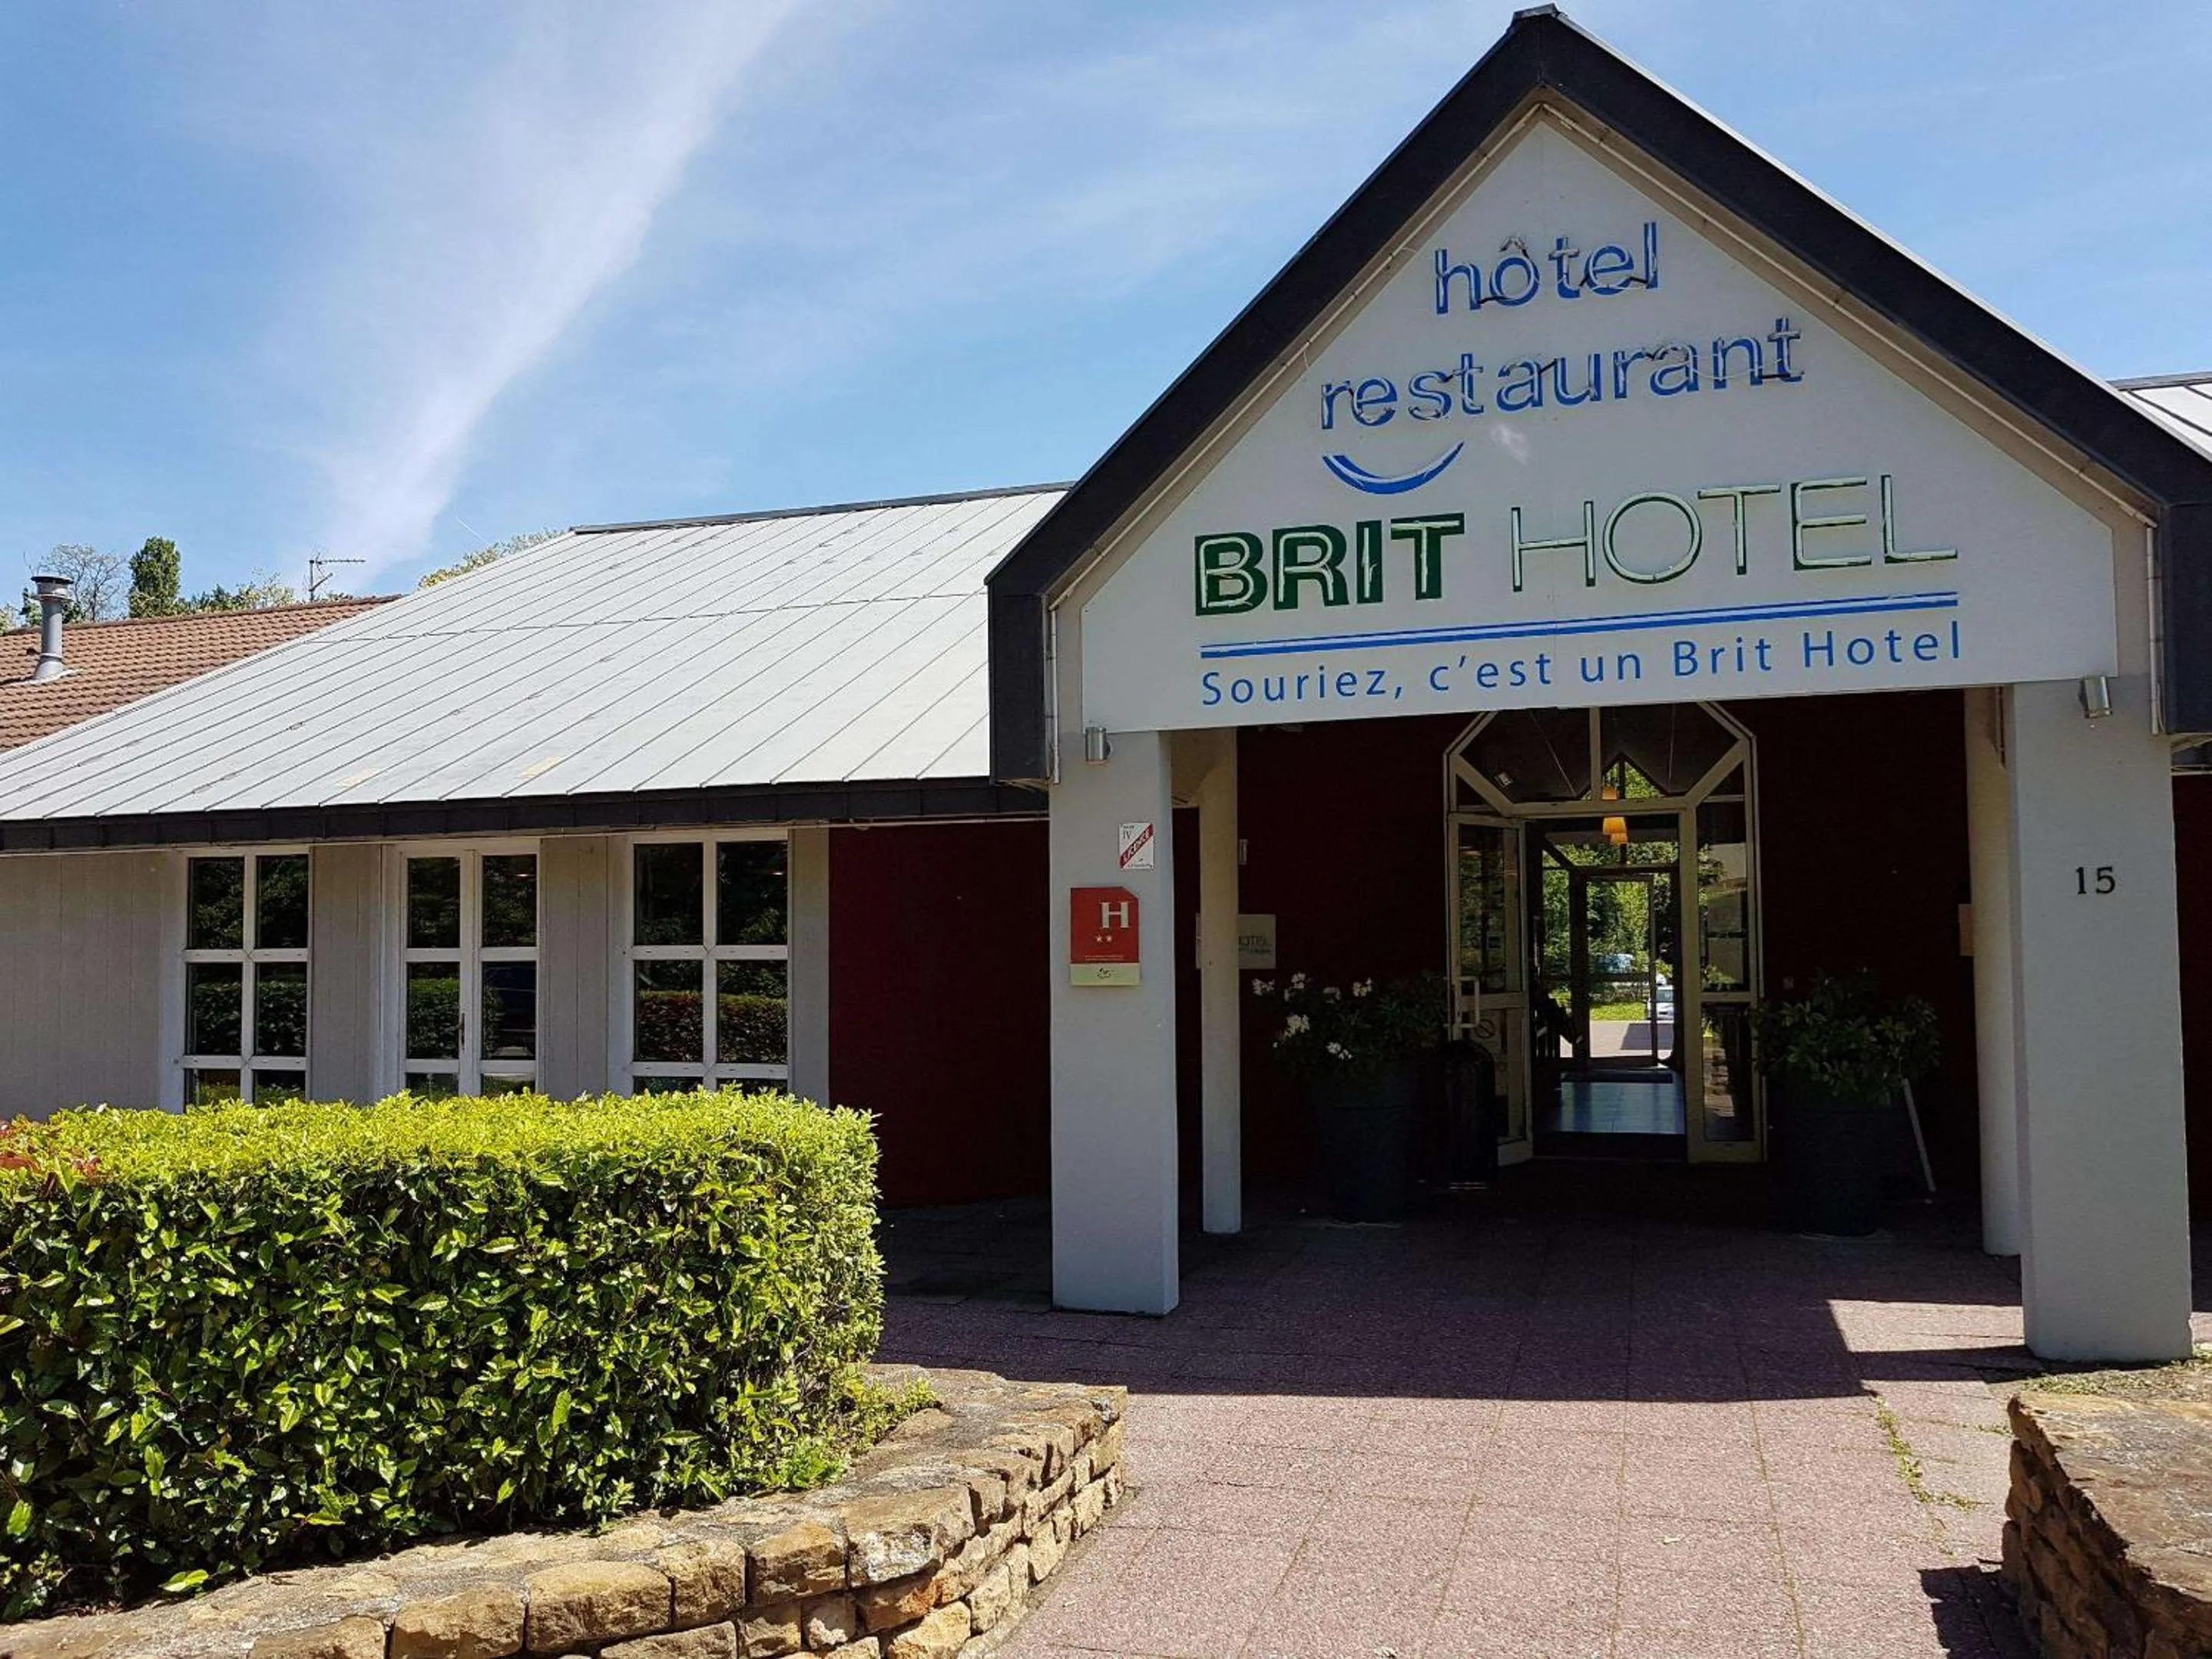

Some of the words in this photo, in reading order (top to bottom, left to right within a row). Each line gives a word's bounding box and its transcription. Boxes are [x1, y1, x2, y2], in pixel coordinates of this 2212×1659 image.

[1435, 221, 1659, 314] hôtel
[1320, 317, 1803, 429] restaurant
[1195, 512, 1465, 616] BRIT
[1510, 474, 1958, 592] HOTEL
[1202, 665, 1402, 705] Souriez,
[1580, 651, 1643, 682] un
[1674, 637, 1773, 677] Brit
[1803, 621, 1961, 667] Hotel
[1099, 900, 1131, 929] H
[2075, 865, 2116, 896] 15
[1238, 934, 1267, 946] OTEL
